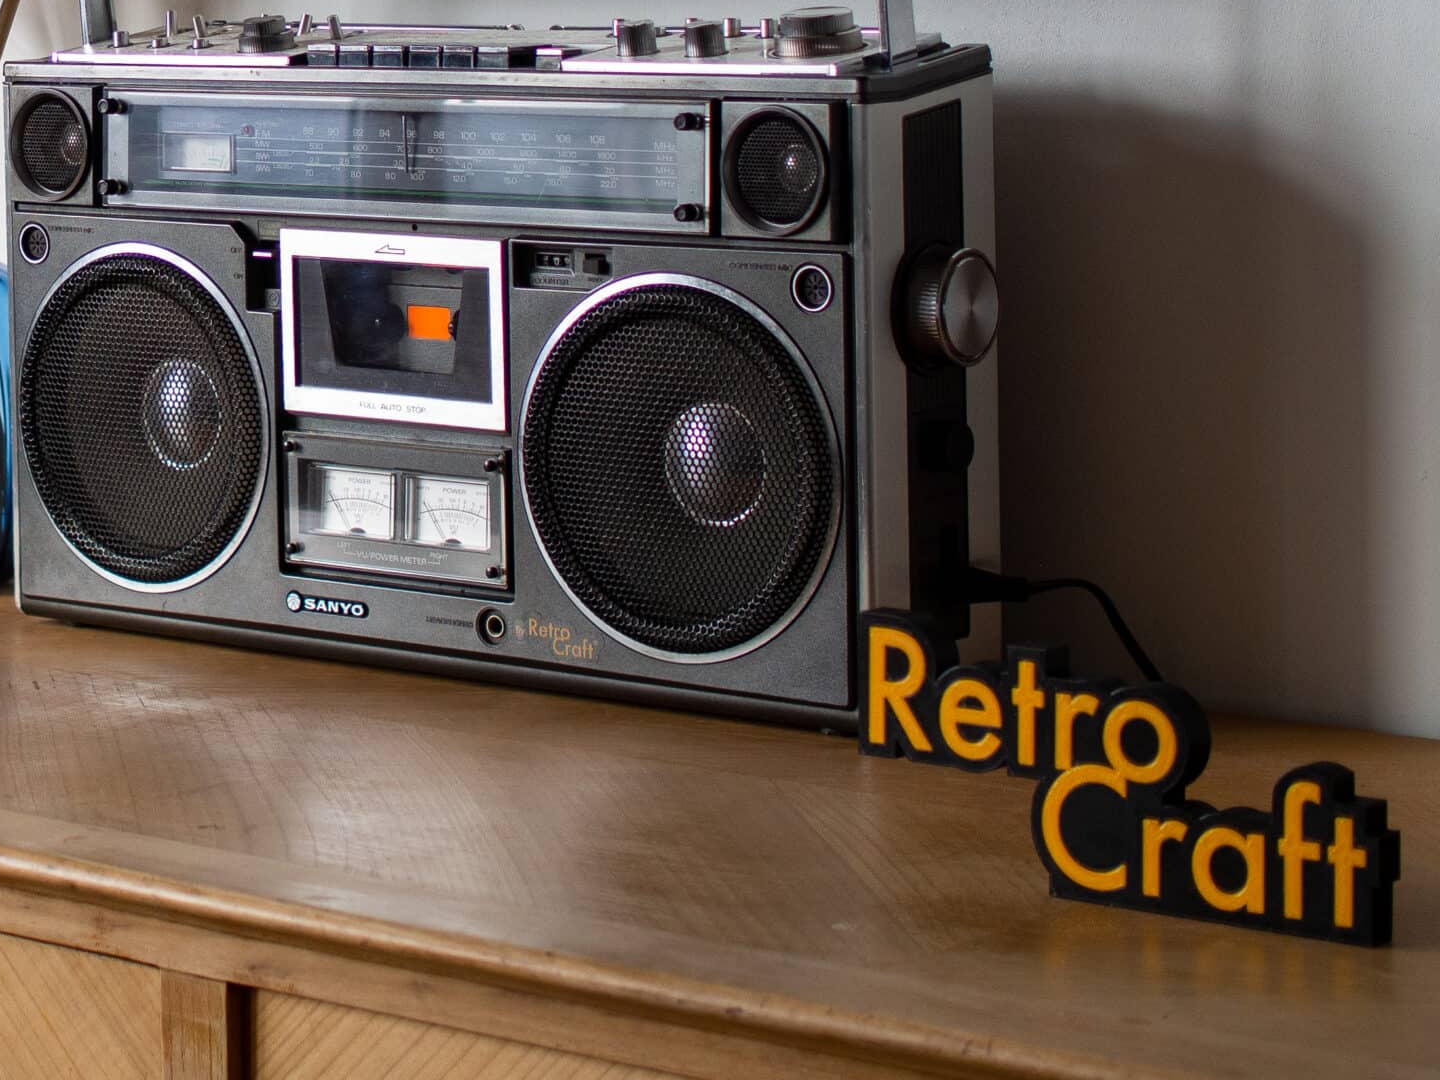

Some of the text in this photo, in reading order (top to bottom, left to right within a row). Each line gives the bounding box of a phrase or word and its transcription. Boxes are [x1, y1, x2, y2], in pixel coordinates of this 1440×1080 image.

[380, 403, 403, 413] AUTO
[405, 405, 427, 414] STOP
[303, 598, 364, 616] SANYO
[528, 617, 571, 641] Retro
[553, 637, 594, 659] Craft
[867, 625, 1178, 785] Retro
[1040, 762, 1368, 929] Craft
